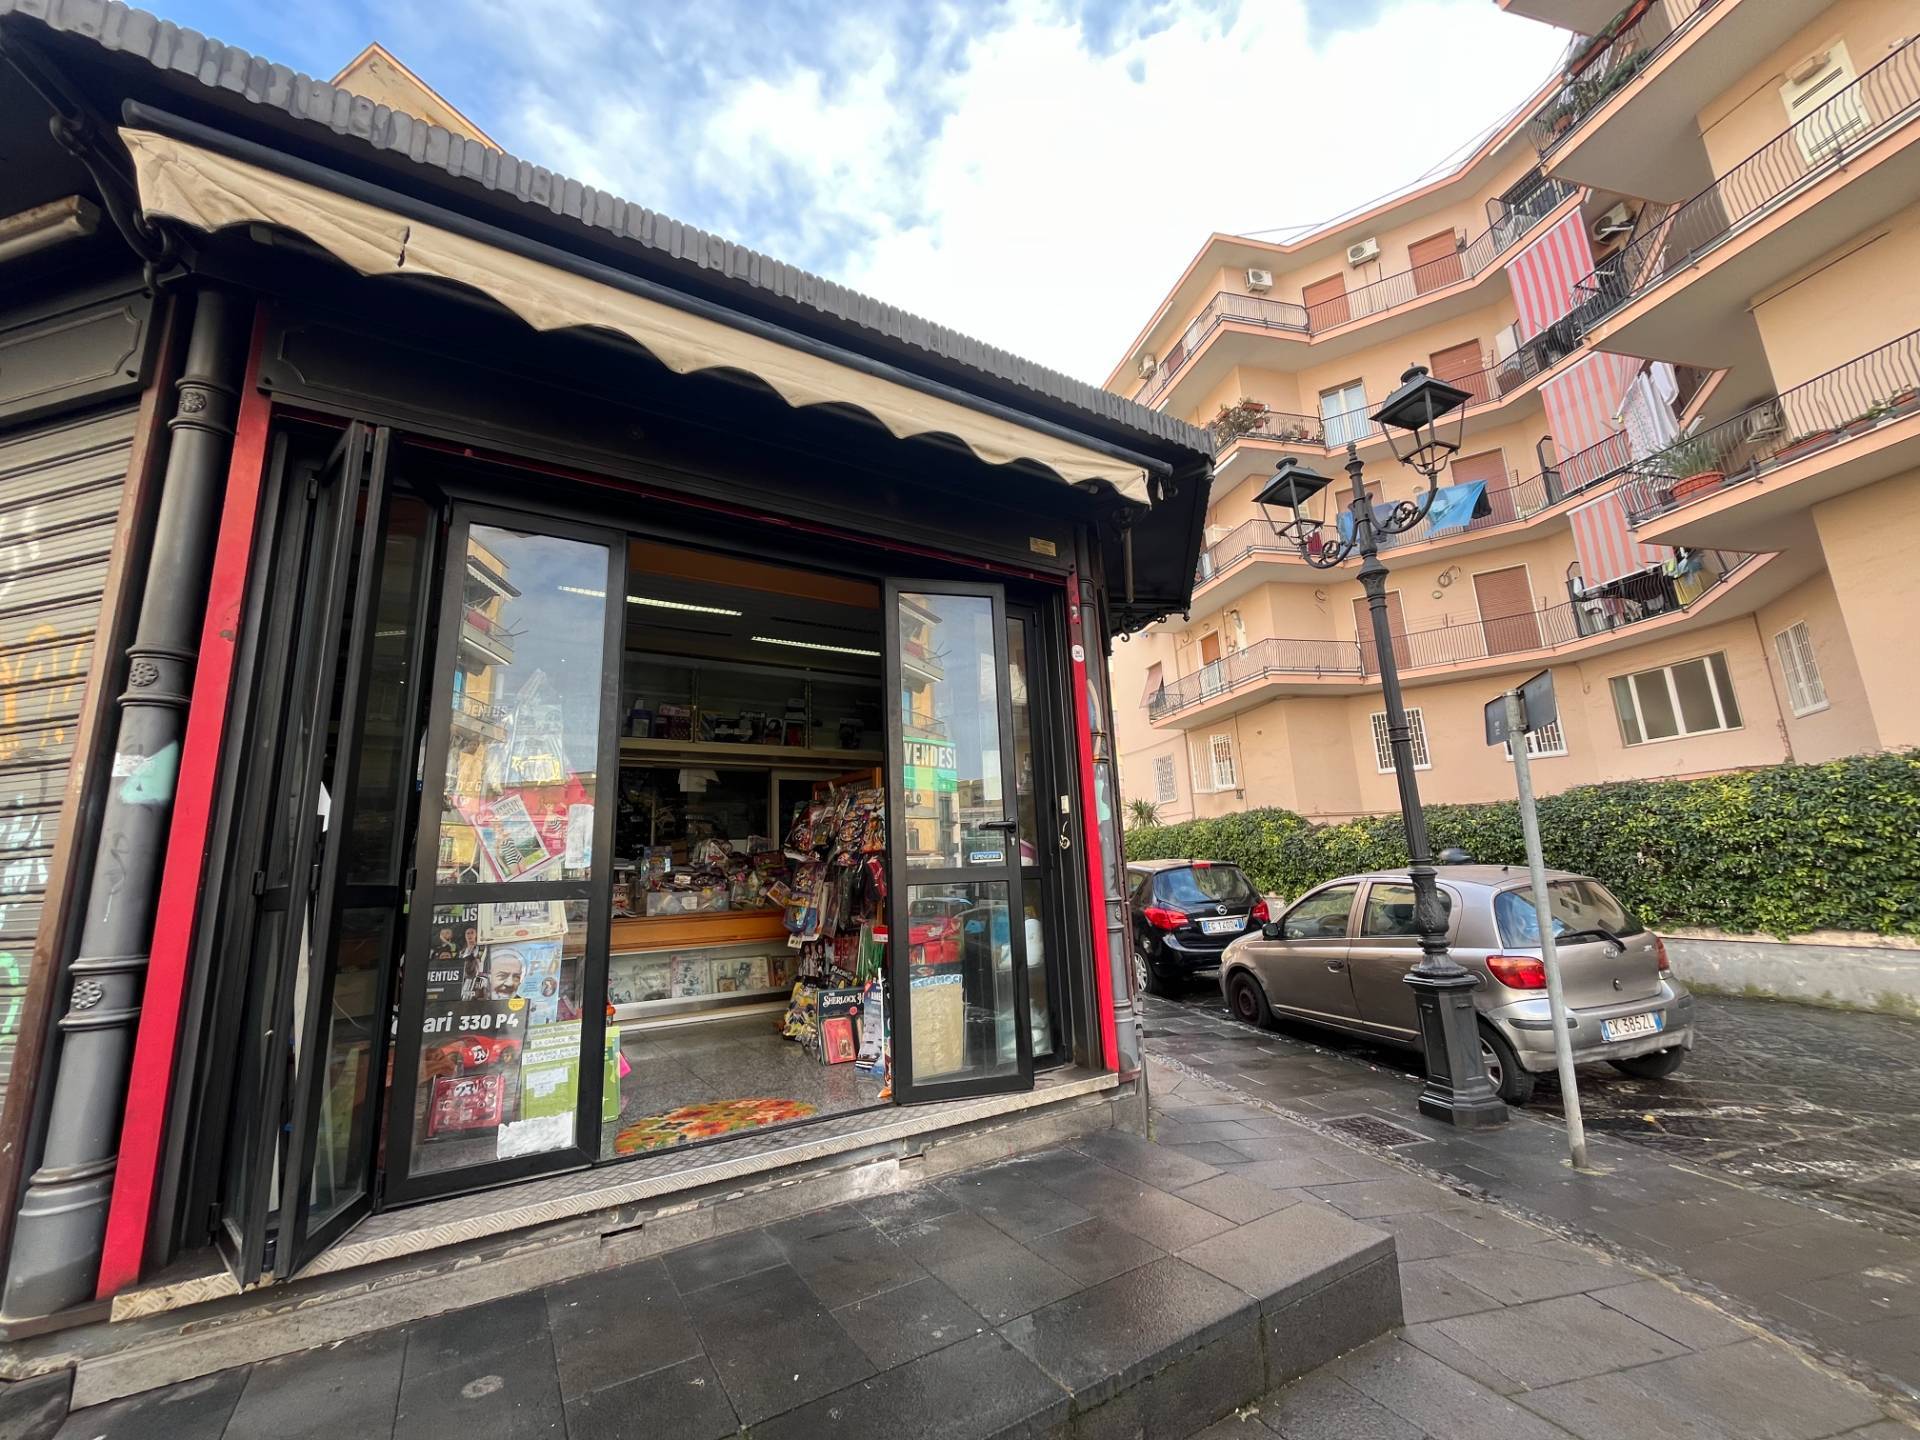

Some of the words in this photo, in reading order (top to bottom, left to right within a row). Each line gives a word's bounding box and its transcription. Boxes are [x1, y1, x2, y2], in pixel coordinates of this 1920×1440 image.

[904, 742, 957, 769] VENDESI
[427, 970, 459, 982] ENTUS
[459, 1014, 491, 1031] 330
[495, 1013, 519, 1029] P4
[1608, 1019, 1621, 1036] CK
[1622, 1014, 1655, 1032] 385ZL
